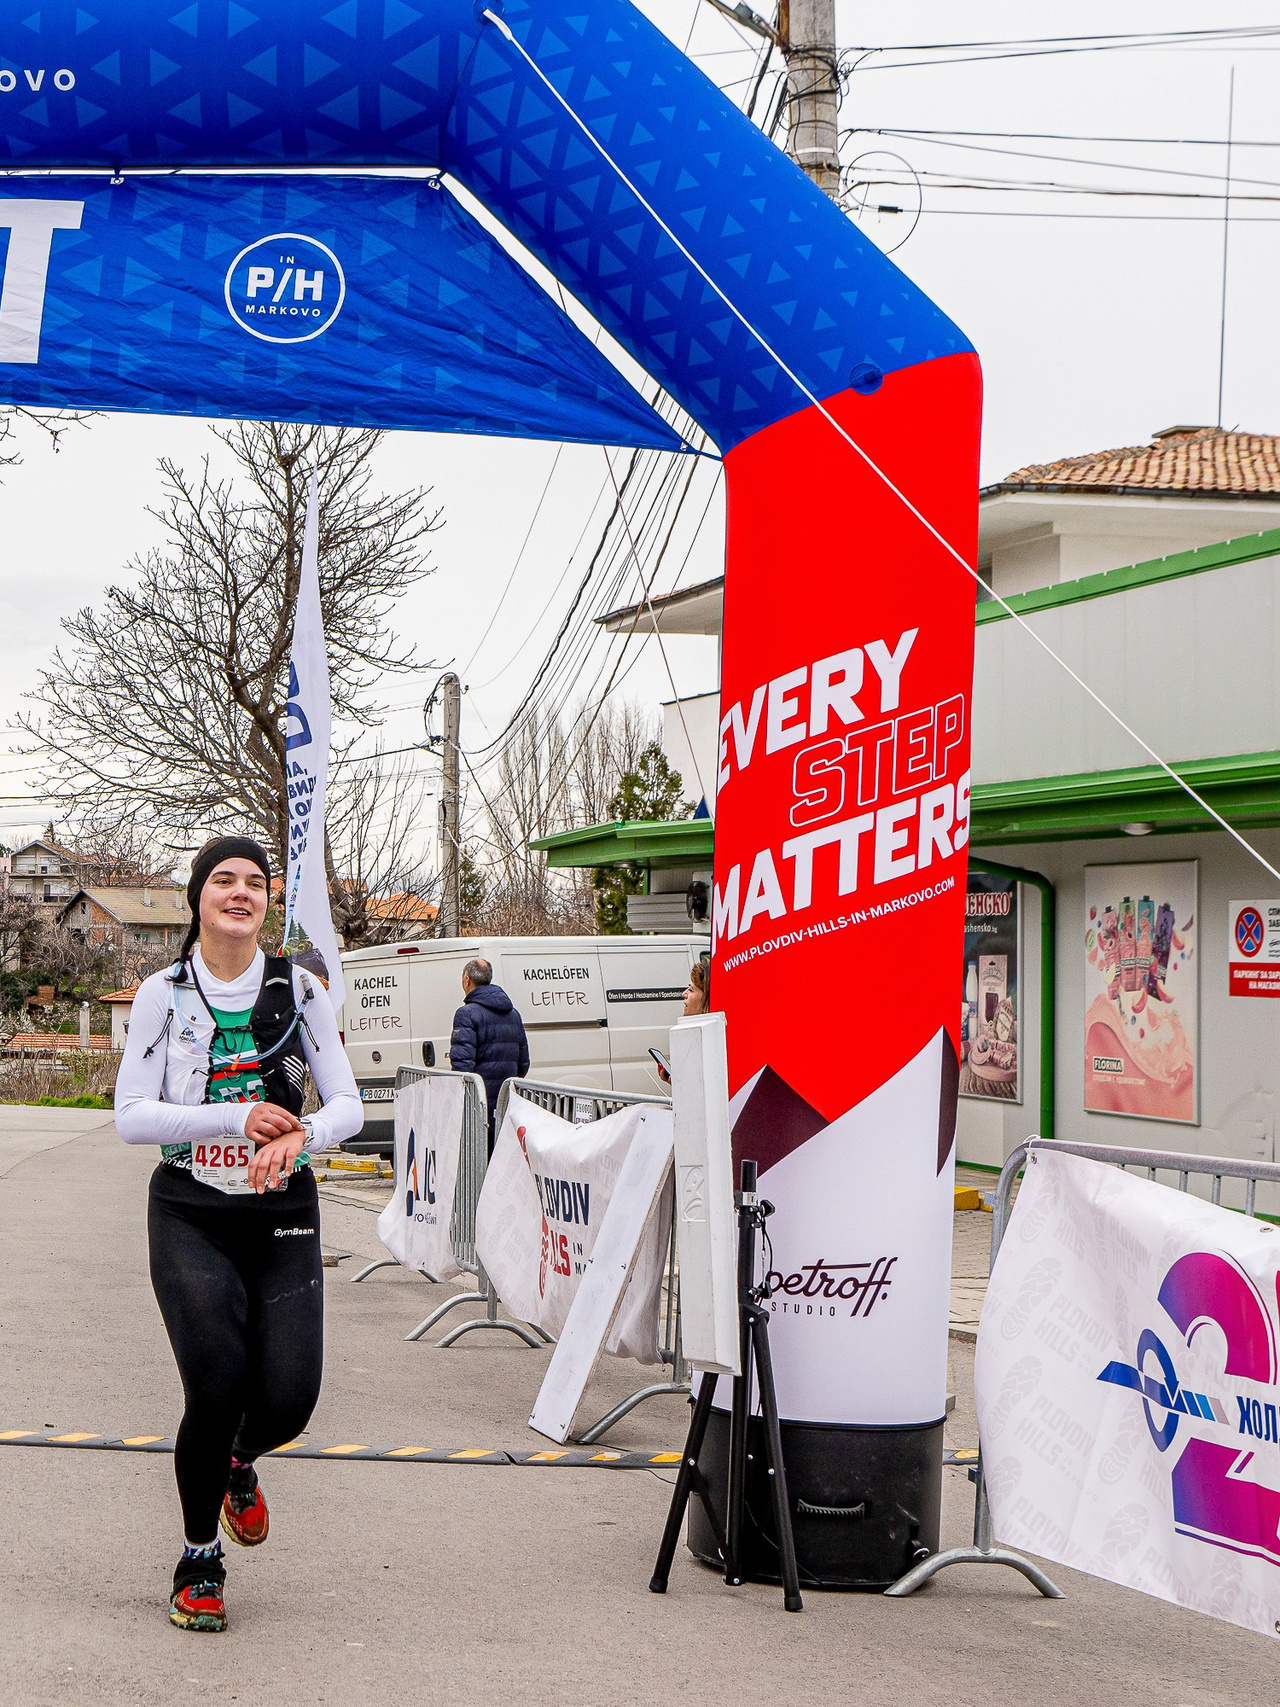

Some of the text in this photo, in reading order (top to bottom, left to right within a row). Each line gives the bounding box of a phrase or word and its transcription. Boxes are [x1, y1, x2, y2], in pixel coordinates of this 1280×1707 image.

[279, 255, 295, 265] IN
[246, 266, 324, 303] P/H
[245, 304, 322, 317] MARKOVO
[717, 627, 919, 796] EVERY
[790, 693, 965, 828] STEP
[711, 768, 971, 958] MATTERS
[723, 876, 955, 972] WWW.PLOVDIV-HILLS-IN-MARKOVO.COM
[523, 965, 590, 981] KACHELÖFEN
[354, 975, 398, 991] KACHEL
[361, 993, 391, 1009] ÖFEN
[531, 991, 590, 1007] LEITER
[350, 1015, 403, 1032] LEITER
[1094, 1059, 1122, 1071] FLORINA
[195, 1145, 249, 1167] 4265
[274, 1228, 314, 1237] GymBeam
[573, 1242, 583, 1255] IN
[771, 1301, 836, 1317] STUDIO
[1236, 1396, 1280, 1443] ХОЛ
